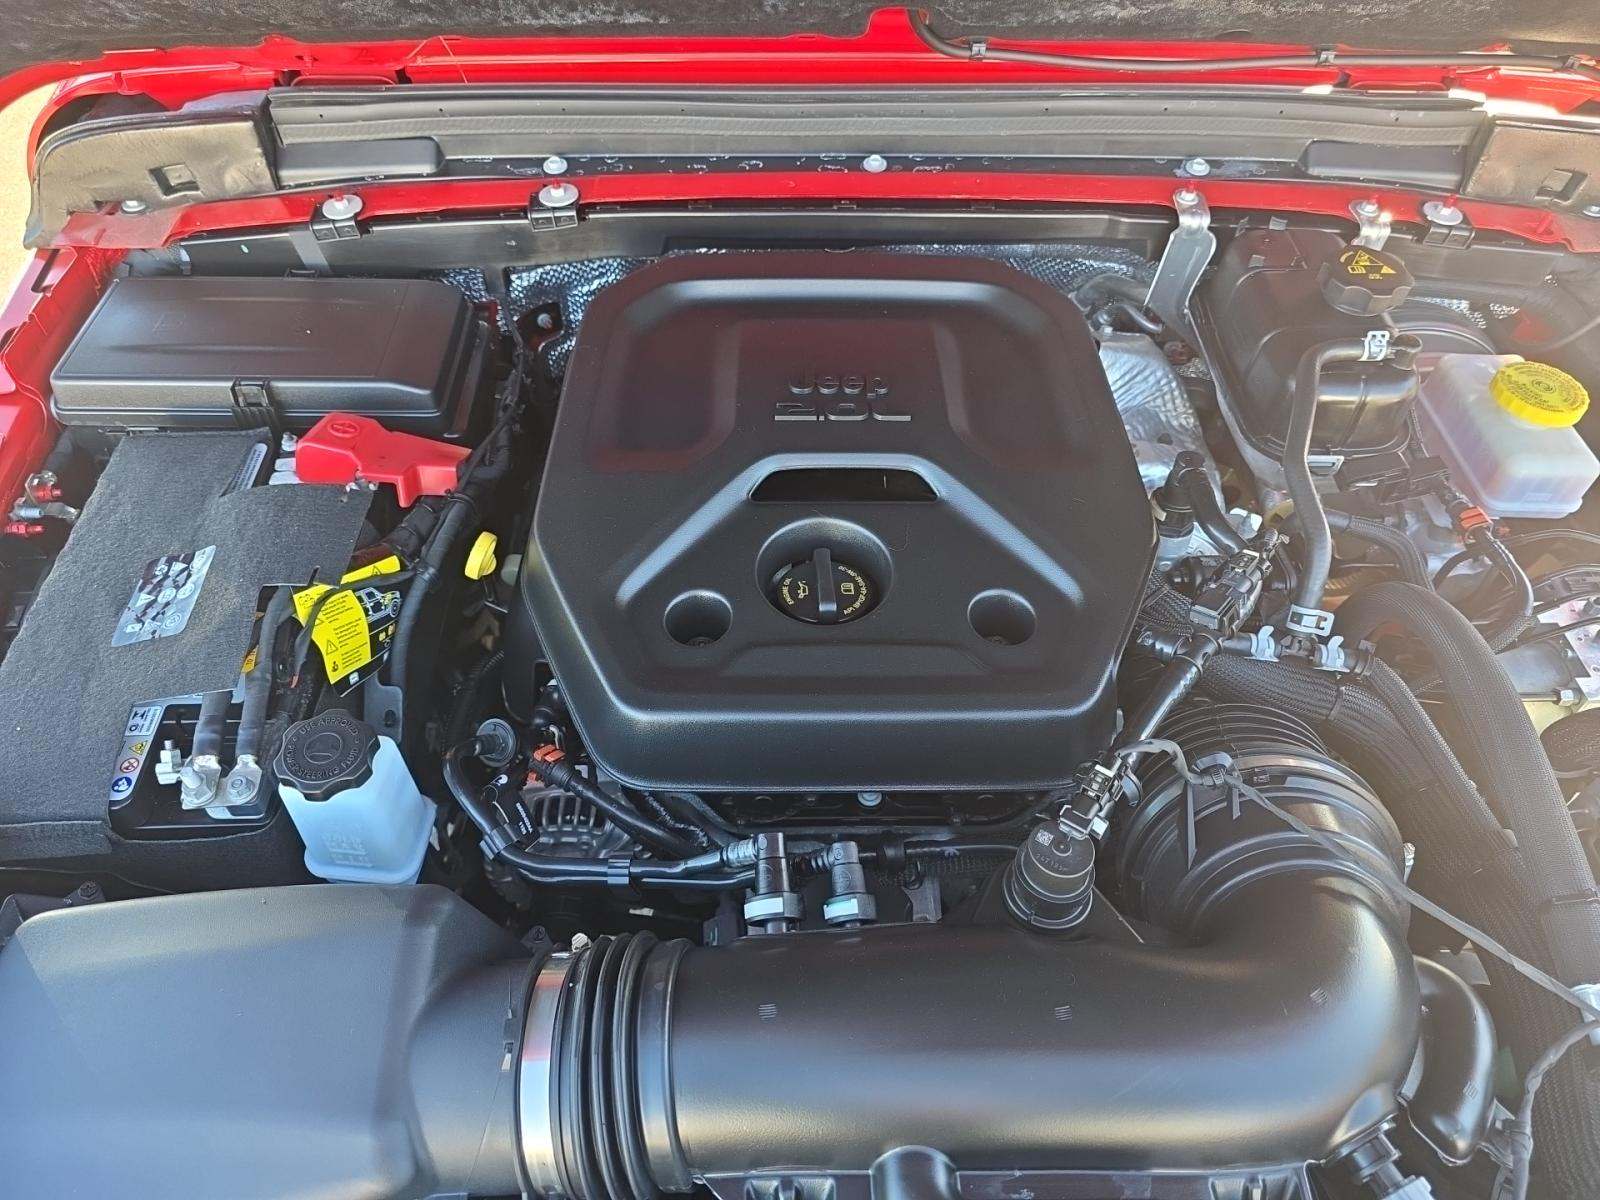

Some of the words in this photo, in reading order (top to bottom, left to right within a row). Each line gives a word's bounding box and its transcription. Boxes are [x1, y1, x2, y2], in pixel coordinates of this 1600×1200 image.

[789, 371, 889, 398] Jeep
[782, 586, 794, 605] ENGINE
[299, 722, 317, 735] USE
[318, 717, 359, 736] APPROVED
[341, 747, 359, 769] FLUID
